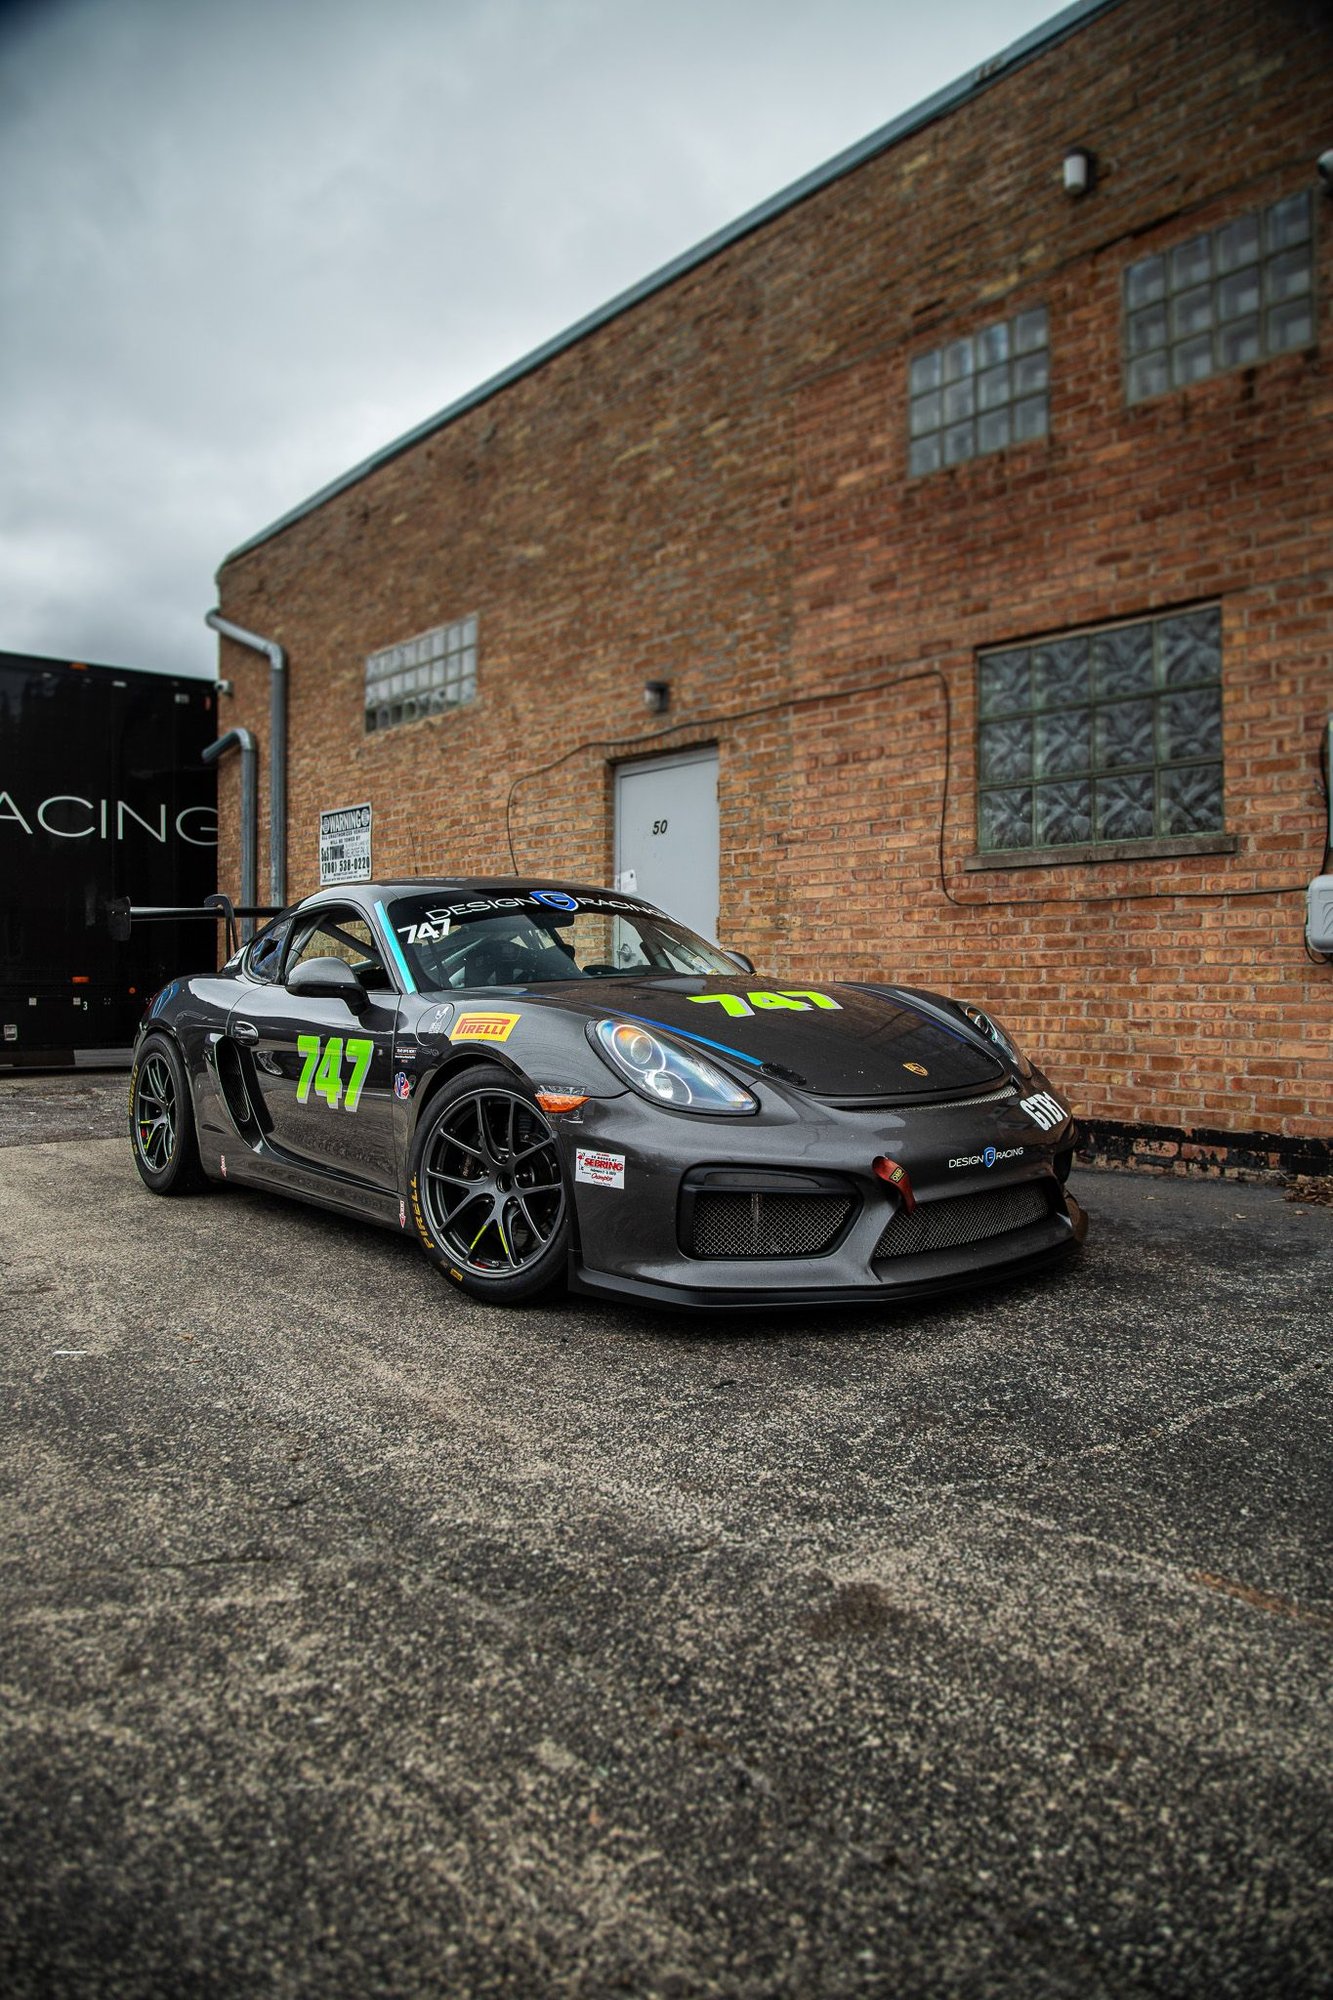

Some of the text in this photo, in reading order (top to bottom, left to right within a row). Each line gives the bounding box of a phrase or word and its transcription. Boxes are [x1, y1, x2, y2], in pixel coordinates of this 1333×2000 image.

[328, 810, 362, 833] WARNING
[652, 819, 668, 835] 50
[425, 896, 540, 921] DESIGN
[397, 918, 451, 945] 747
[82, 1001, 88, 1011] 3
[686, 990, 844, 1018] 747
[455, 1017, 511, 1036] PIRELLI
[296, 1034, 374, 1113] 747
[584, 1157, 624, 1172] SEBRING
[948, 1147, 1024, 1168] DESIGN RACING
